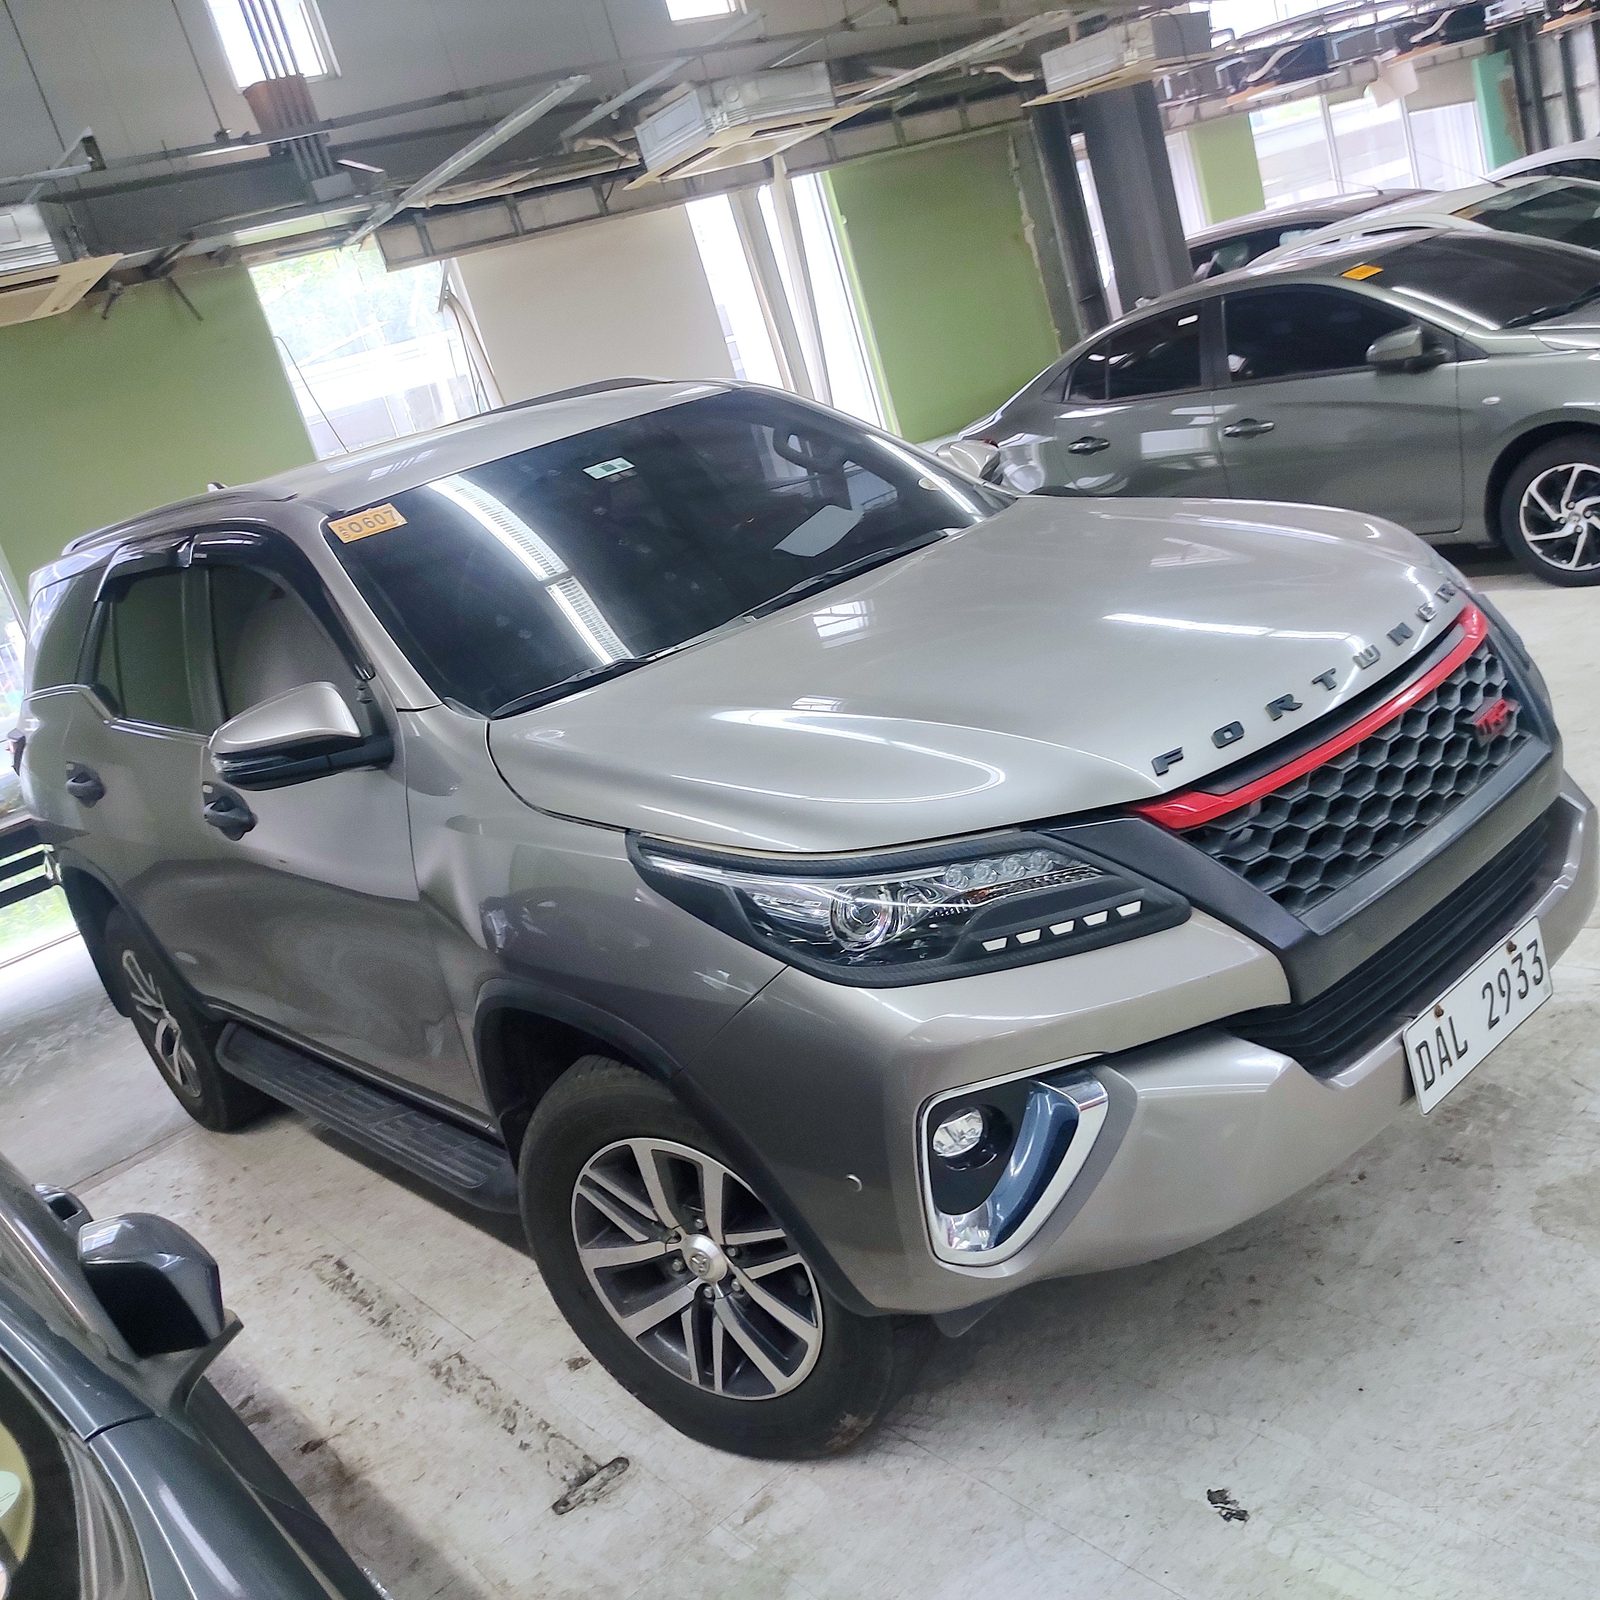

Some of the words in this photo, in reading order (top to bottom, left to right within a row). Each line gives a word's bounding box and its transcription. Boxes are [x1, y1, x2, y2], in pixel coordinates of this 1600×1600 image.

[1151, 583, 1455, 777] FORTUNER
[1415, 1016, 1469, 1091] DAL
[1482, 938, 1544, 1030] 2933
